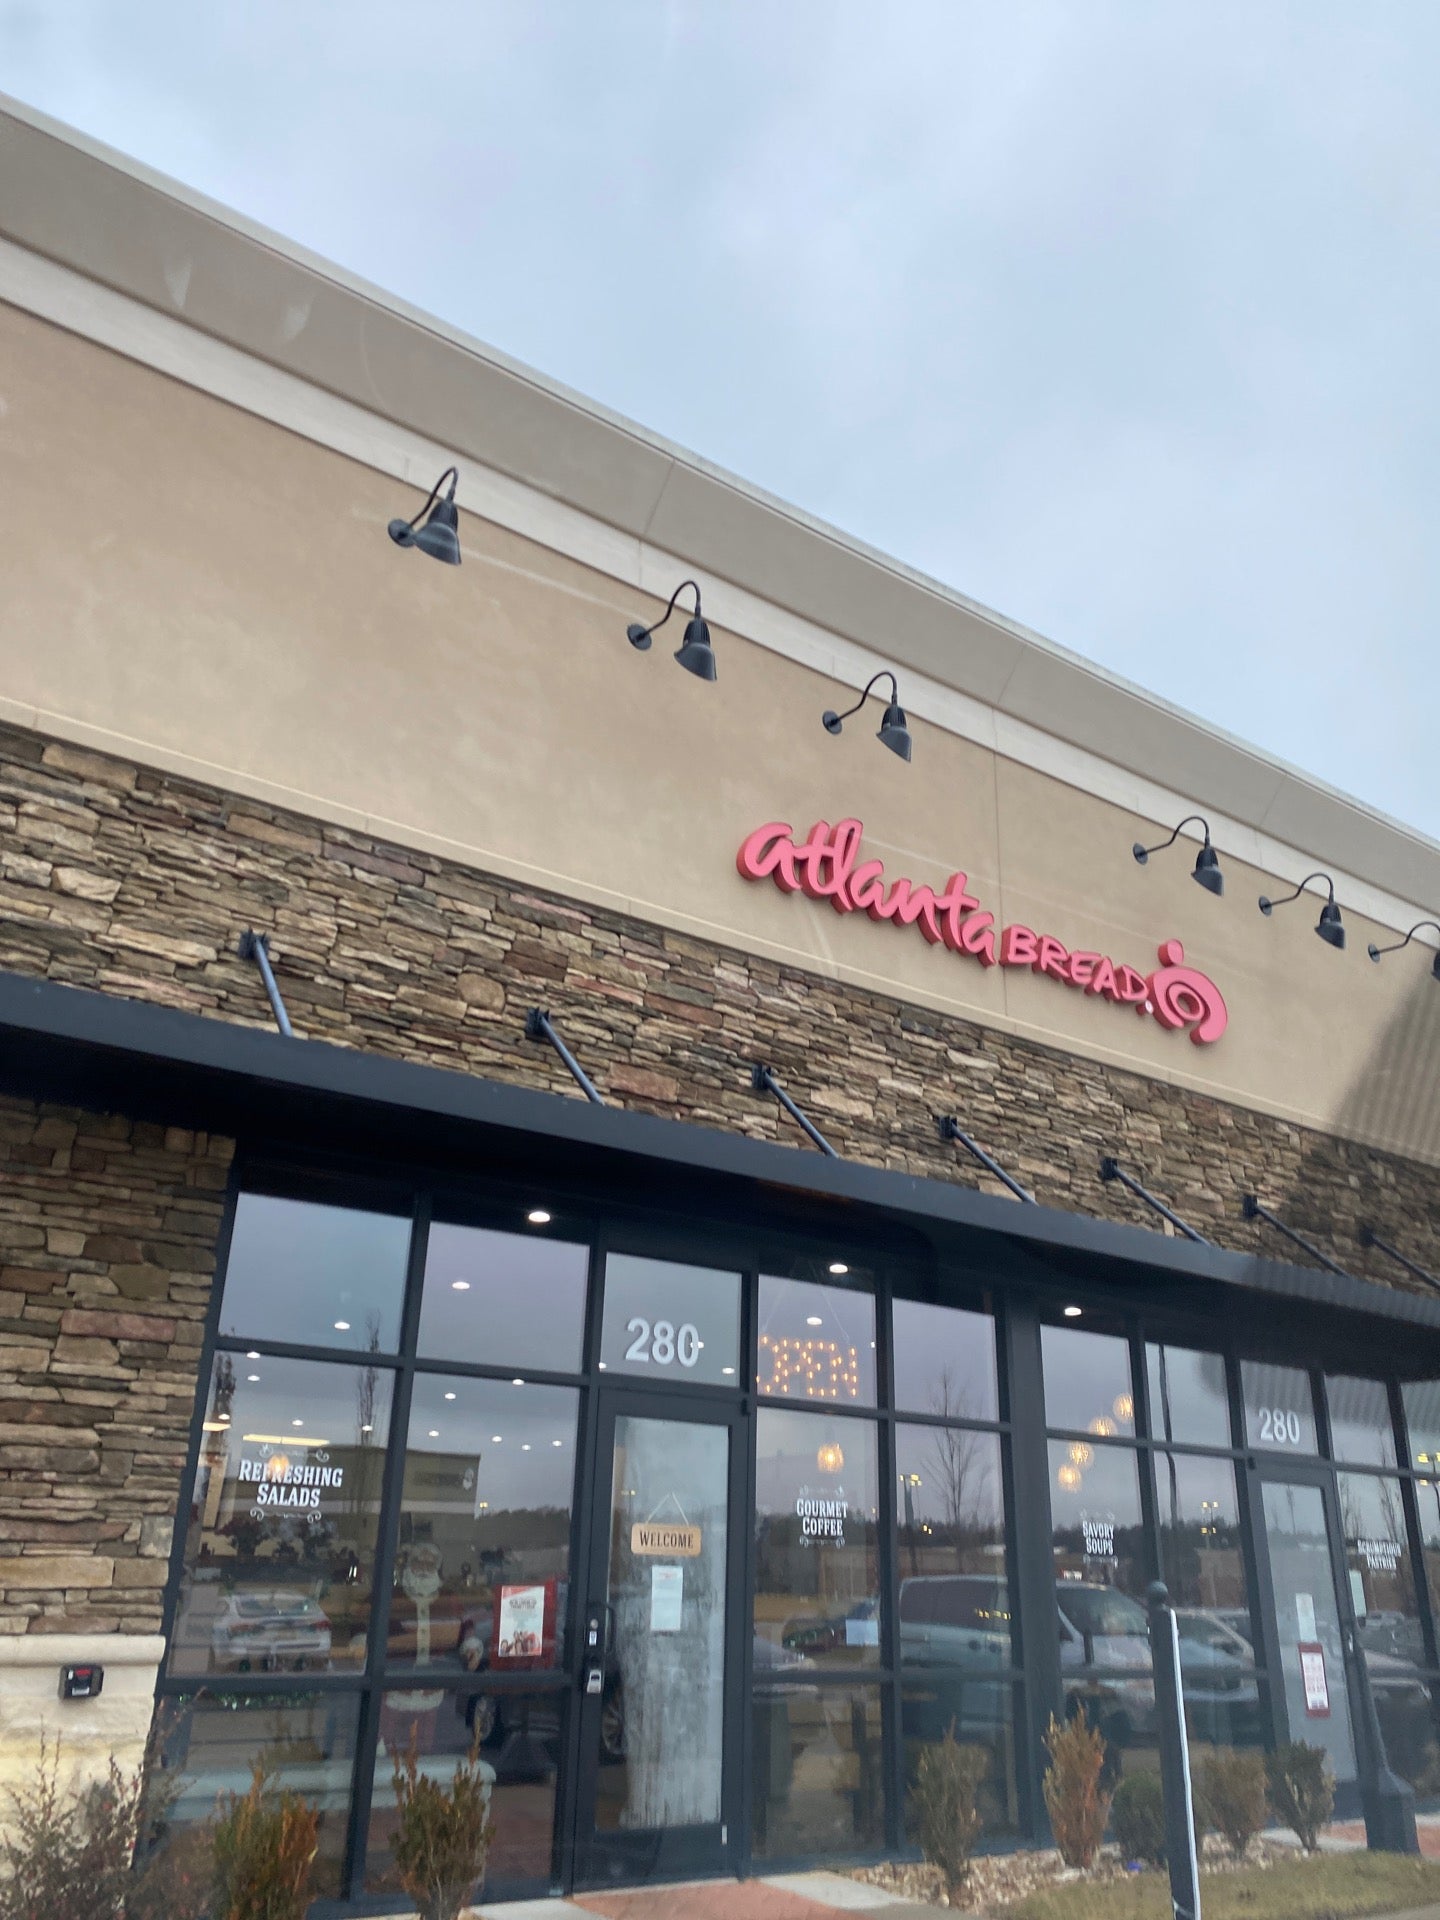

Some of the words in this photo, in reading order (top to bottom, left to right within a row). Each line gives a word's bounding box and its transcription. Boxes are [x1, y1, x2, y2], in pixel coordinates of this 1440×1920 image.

[999, 924, 1149, 1005] BREAD
[625, 1316, 701, 1368] 280
[1259, 1406, 1300, 1444] 280
[238, 1459, 343, 1488] REFRESHING
[256, 1483, 321, 1508] SALADS
[796, 1498, 848, 1518] GOURMET
[802, 1516, 843, 1536] COFFEE
[1082, 1520, 1114, 1540] SAVORY
[639, 1530, 694, 1549] WELCOME
[1086, 1537, 1114, 1555] SOUPS
